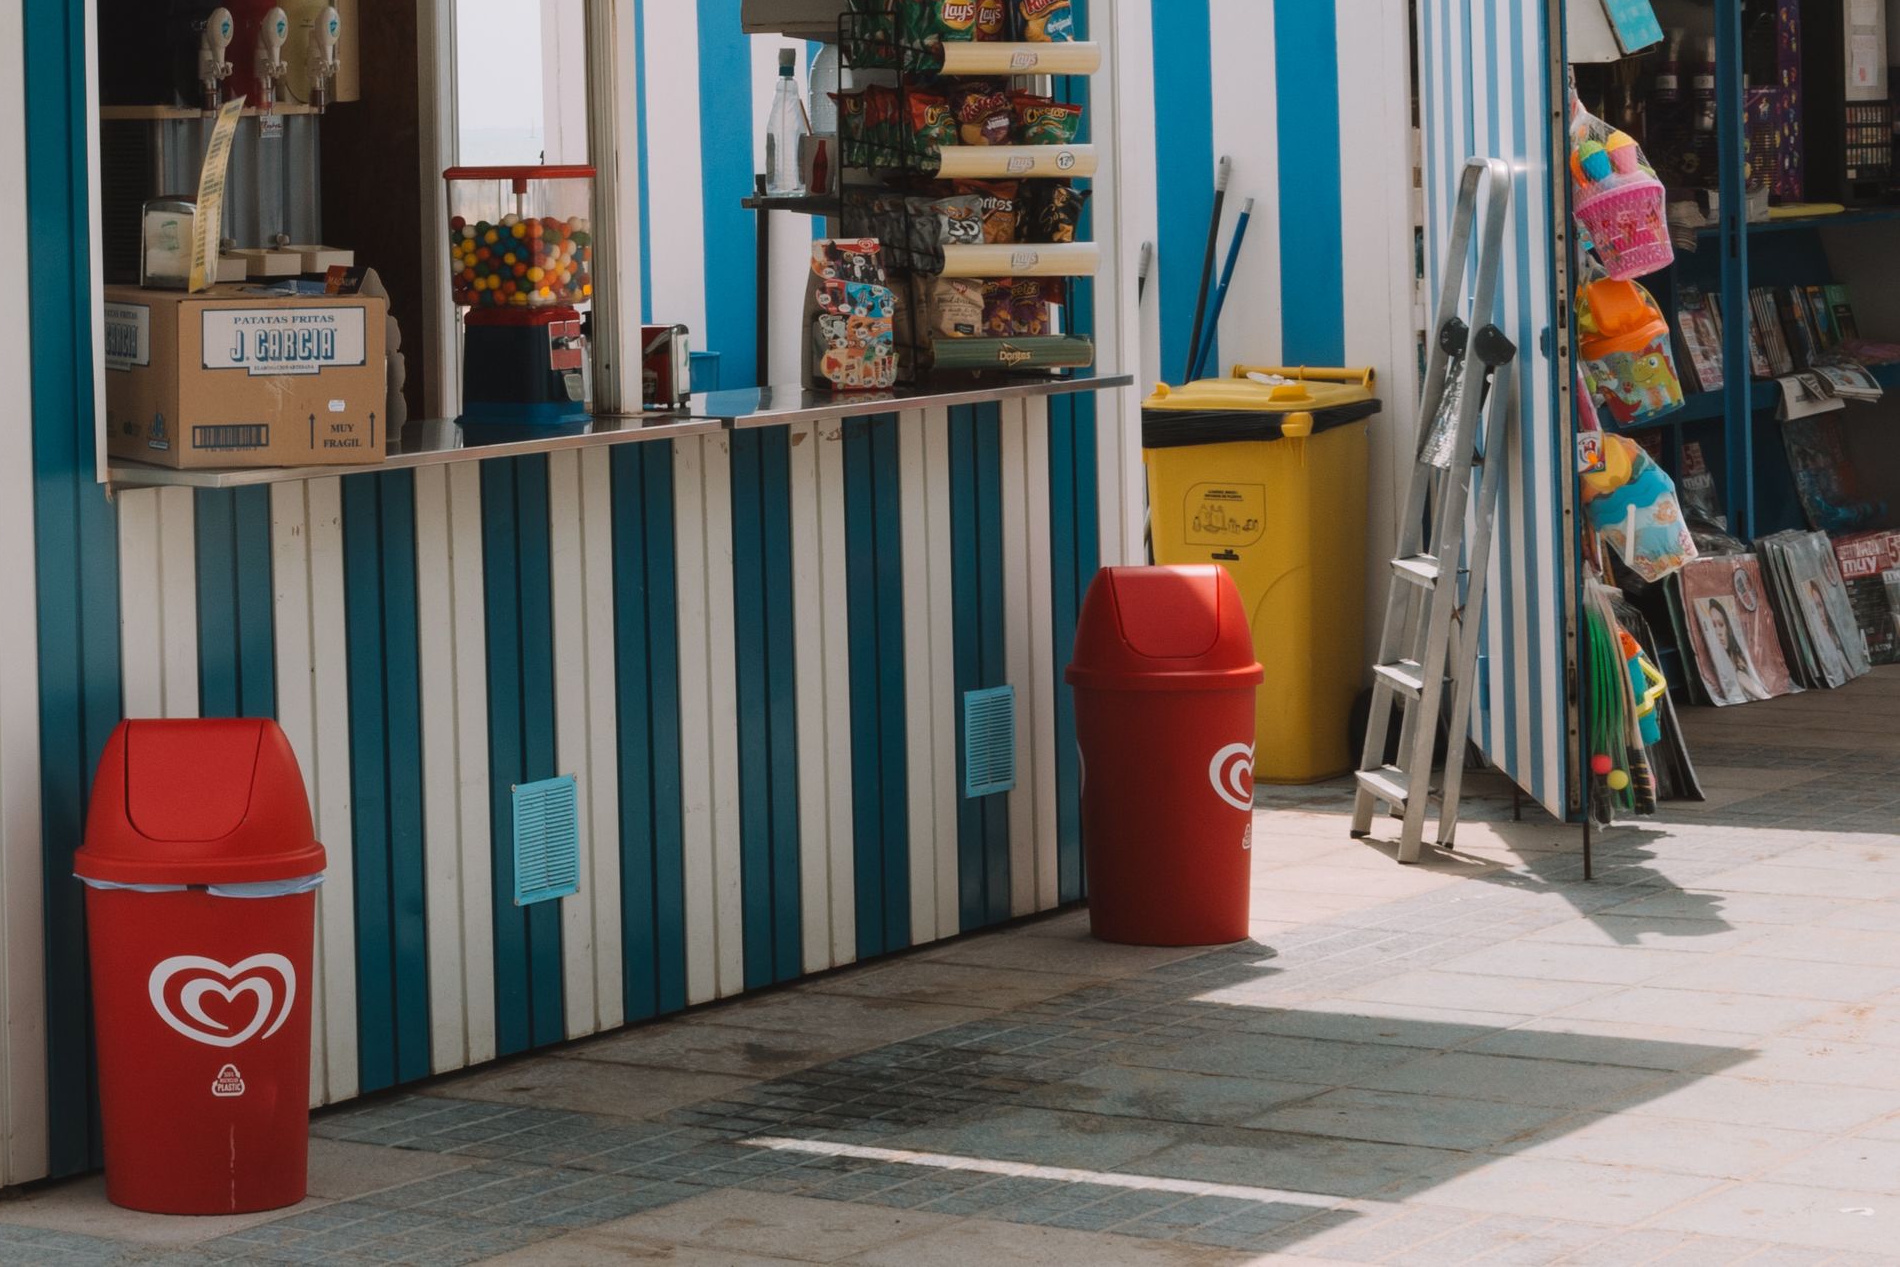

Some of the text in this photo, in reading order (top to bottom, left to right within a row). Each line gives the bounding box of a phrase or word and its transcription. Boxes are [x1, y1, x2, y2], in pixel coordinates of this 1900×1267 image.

[944, 3, 975, 22] Lay's
[979, 7, 1002, 25] Lay's
[1011, 51, 1038, 70] Lay's
[1024, 107, 1069, 124] Cheetos
[1007, 156, 1035, 174] Lay's
[979, 196, 1013, 212] oritos
[1011, 252, 1038, 270] Lay's
[234, 315, 335, 325] PATATAS FRITAS
[230, 328, 335, 363] J. GARCIA
[999, 349, 1031, 362] Doritos
[330, 423, 355, 433] MUY
[323, 438, 362, 449] FRAGIL
[1842, 556, 1877, 574] muy
[217, 1084, 241, 1092] PLASTIC
